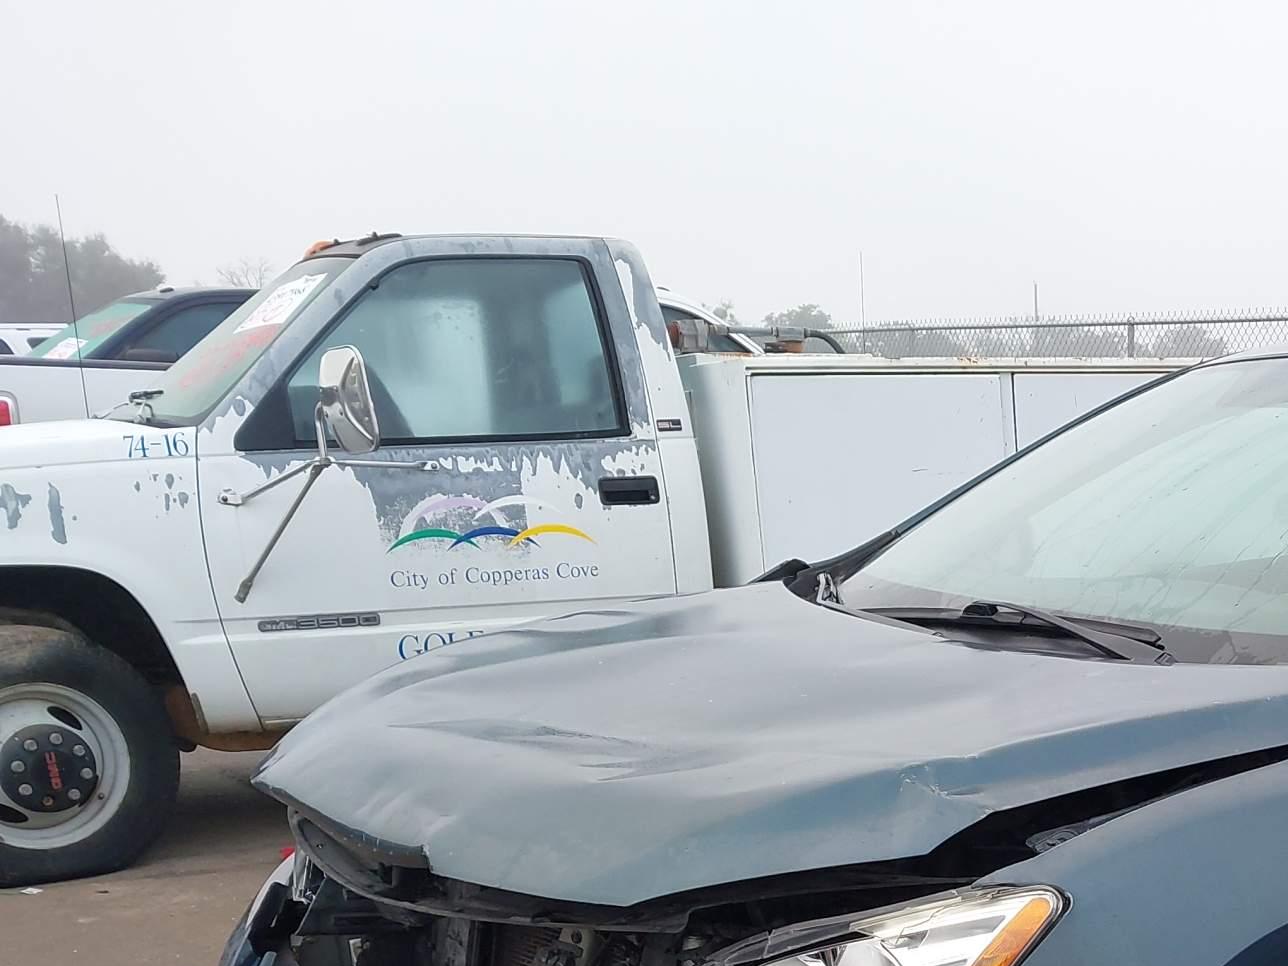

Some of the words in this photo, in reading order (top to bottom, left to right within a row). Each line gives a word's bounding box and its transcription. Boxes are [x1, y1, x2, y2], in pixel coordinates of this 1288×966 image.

[122, 432, 189, 458] 74-16
[390, 570, 429, 589] City
[438, 568, 458, 585] of
[465, 566, 550, 586] Copperas
[556, 562, 600, 579] Cove
[299, 614, 379, 629] 3500
